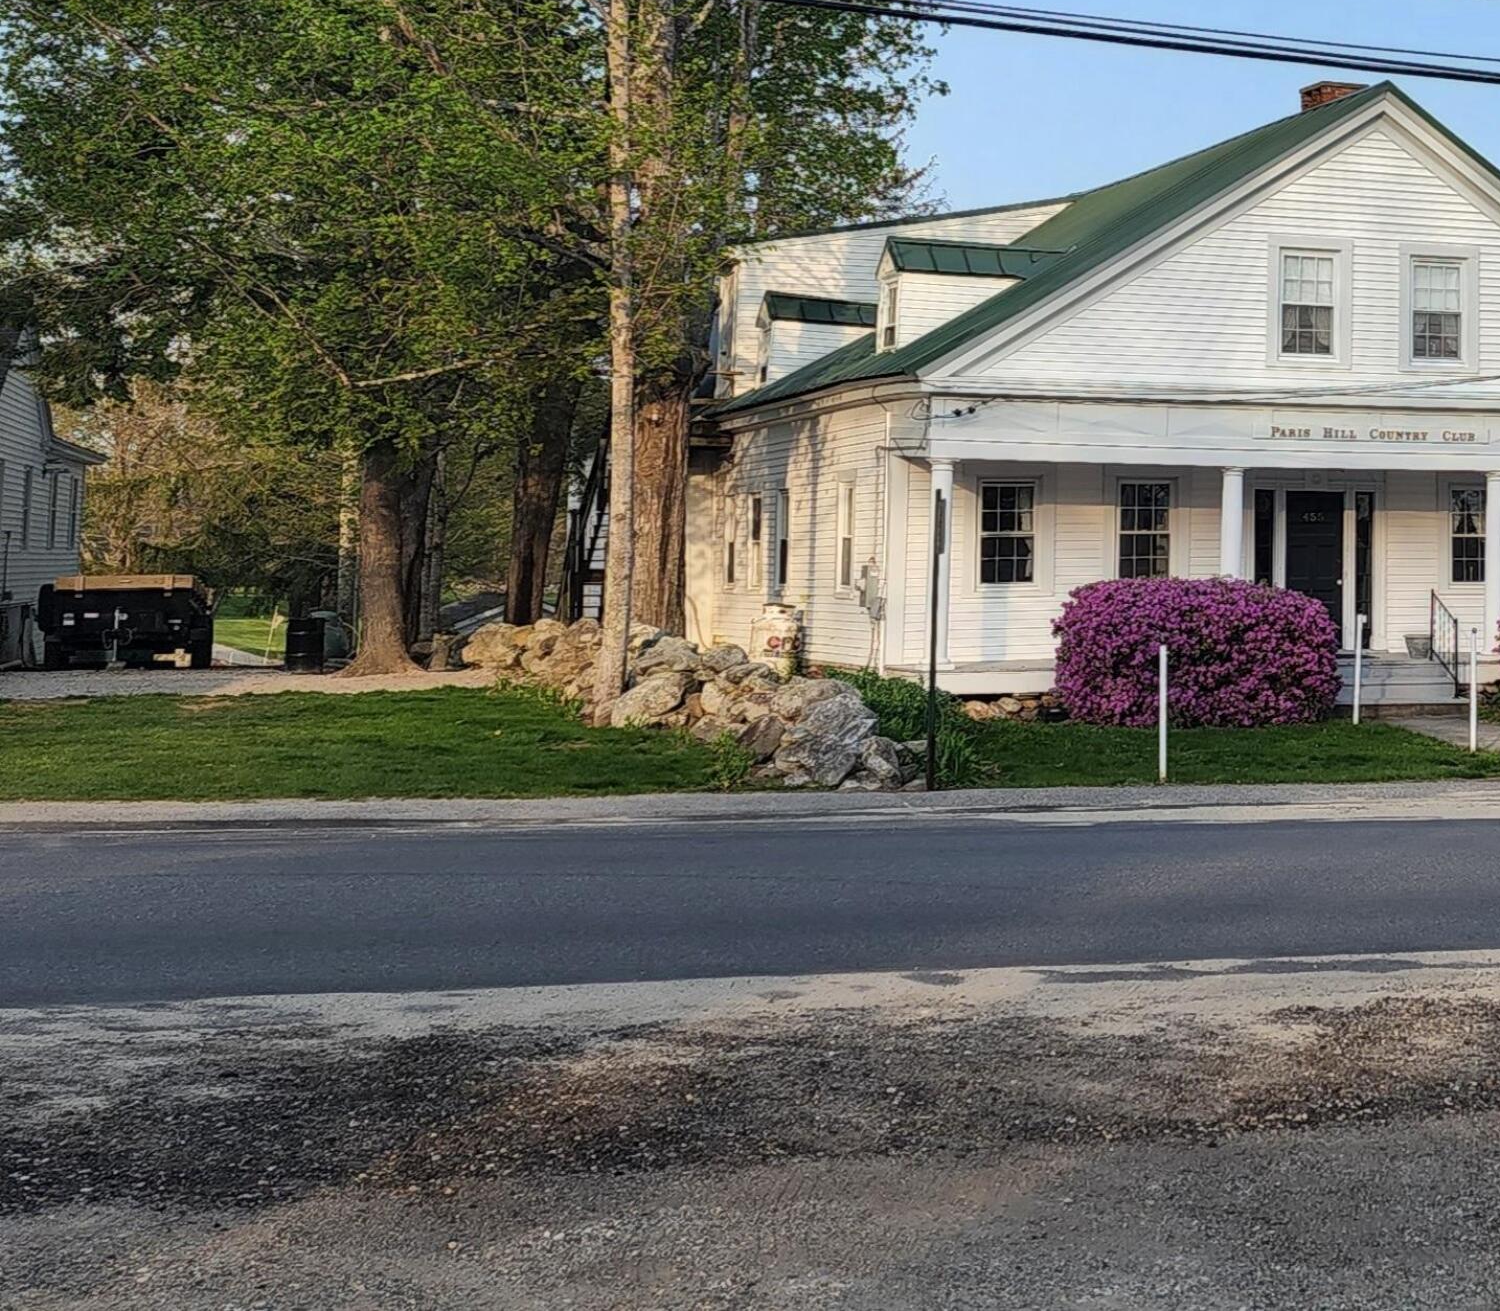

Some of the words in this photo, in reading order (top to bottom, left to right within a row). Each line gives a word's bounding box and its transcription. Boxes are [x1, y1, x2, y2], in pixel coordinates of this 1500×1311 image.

[1271, 425, 1311, 438] PARIS
[1323, 426, 1357, 439] HILL
[1369, 428, 1428, 441] COUNTRY
[1442, 430, 1476, 442] CLUB
